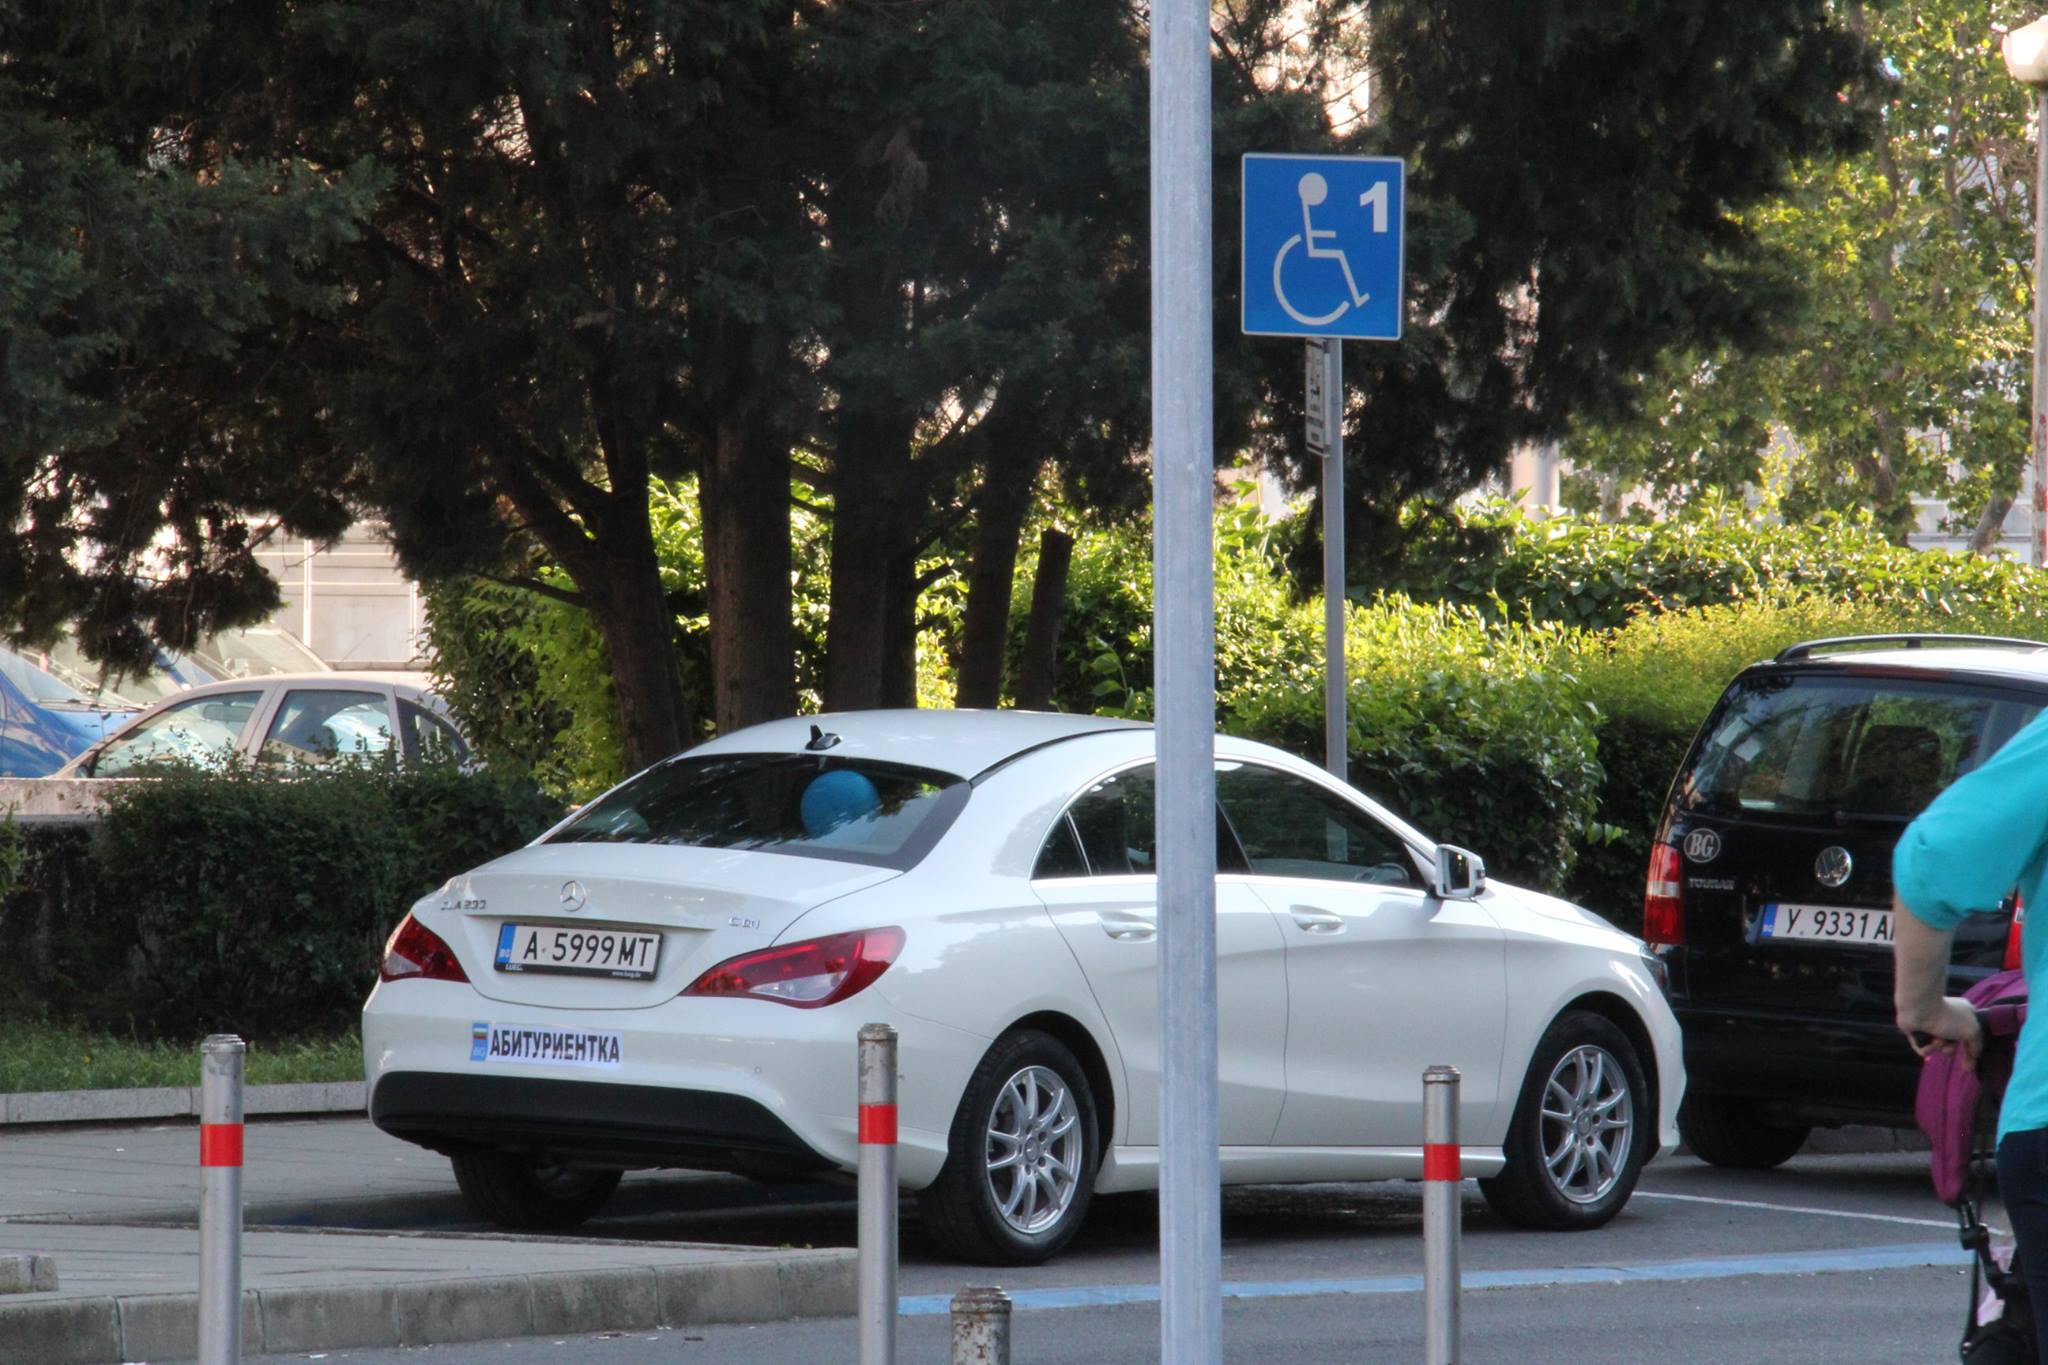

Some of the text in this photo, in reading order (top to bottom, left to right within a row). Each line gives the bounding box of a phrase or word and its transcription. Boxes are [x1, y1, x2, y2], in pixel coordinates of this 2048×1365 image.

[1359, 181, 1389, 233] 1
[1690, 833, 1714, 858] BG
[489, 1029, 620, 1063] АБИТУРИЕНТКА
